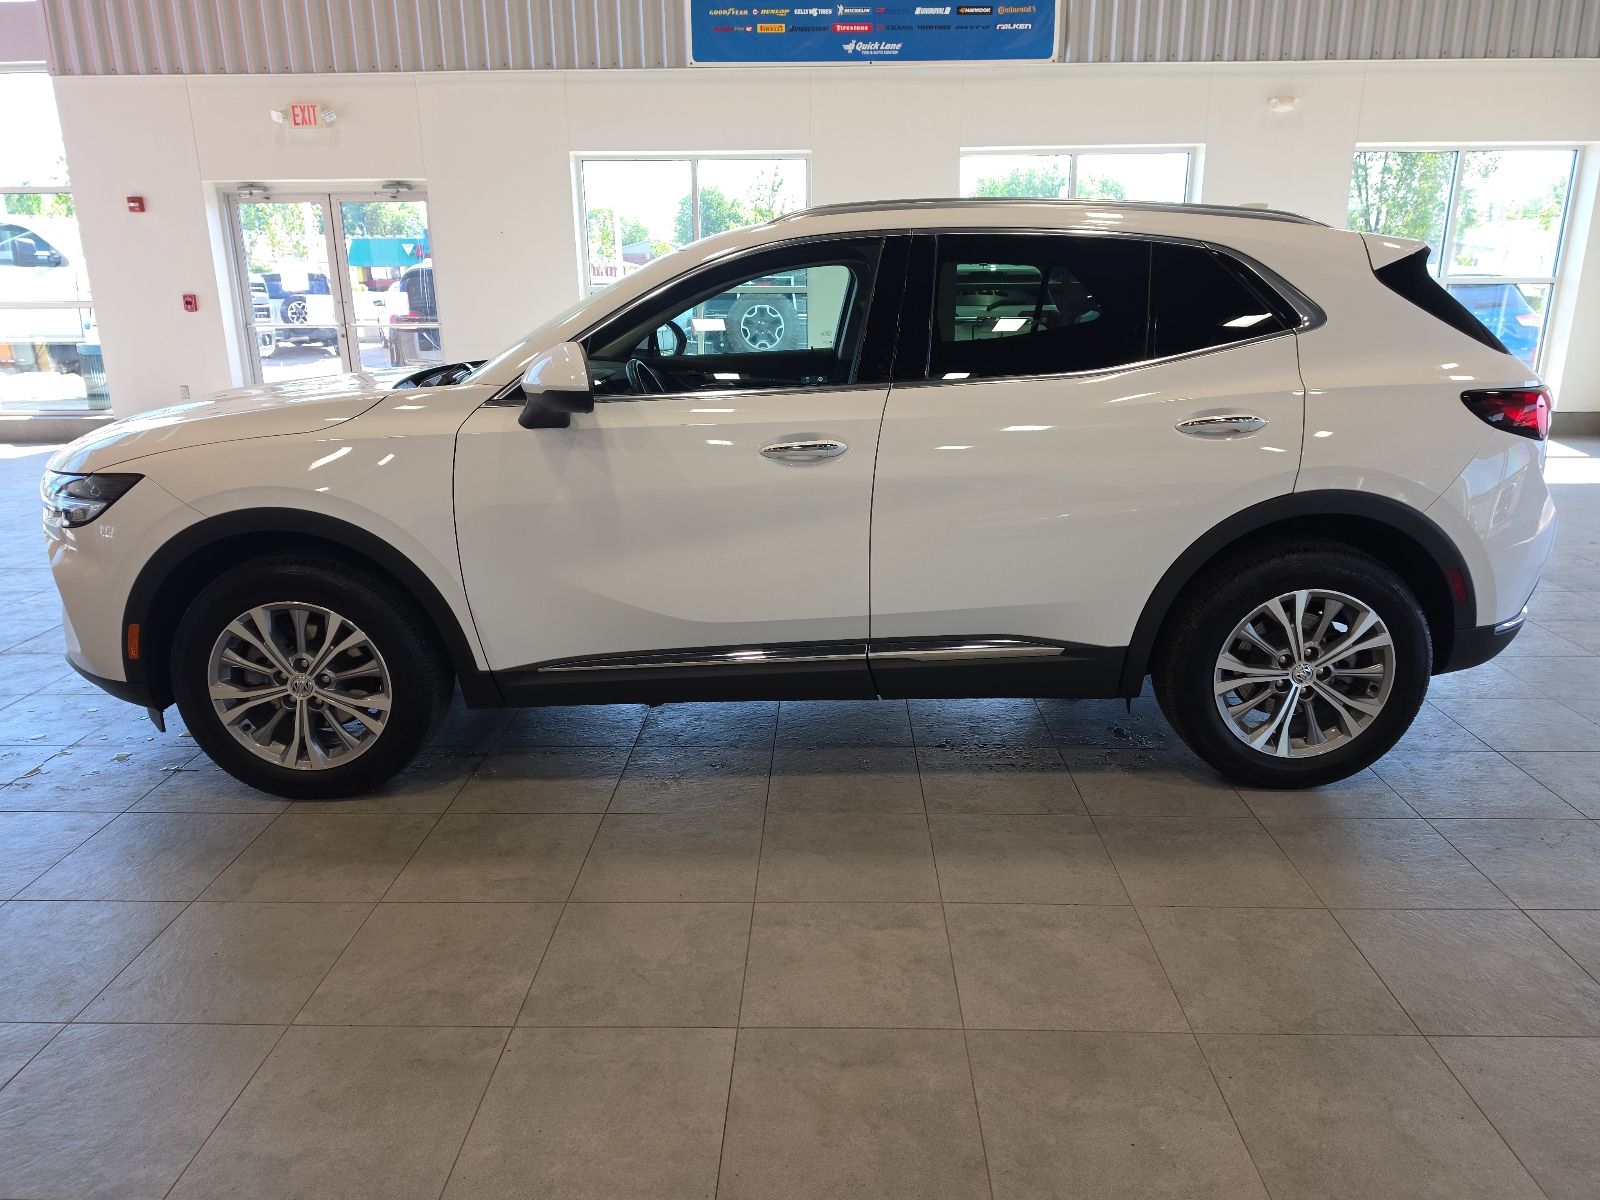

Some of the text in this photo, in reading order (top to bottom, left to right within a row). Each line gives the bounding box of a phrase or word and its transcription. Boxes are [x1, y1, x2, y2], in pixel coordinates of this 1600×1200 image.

[709, 8, 749, 16] GOODYEAR
[997, 6, 1032, 15] Continental
[836, 24, 869, 32] Firestone
[856, 42, 902, 51] Quick Lane
[291, 104, 317, 126] EXIT
